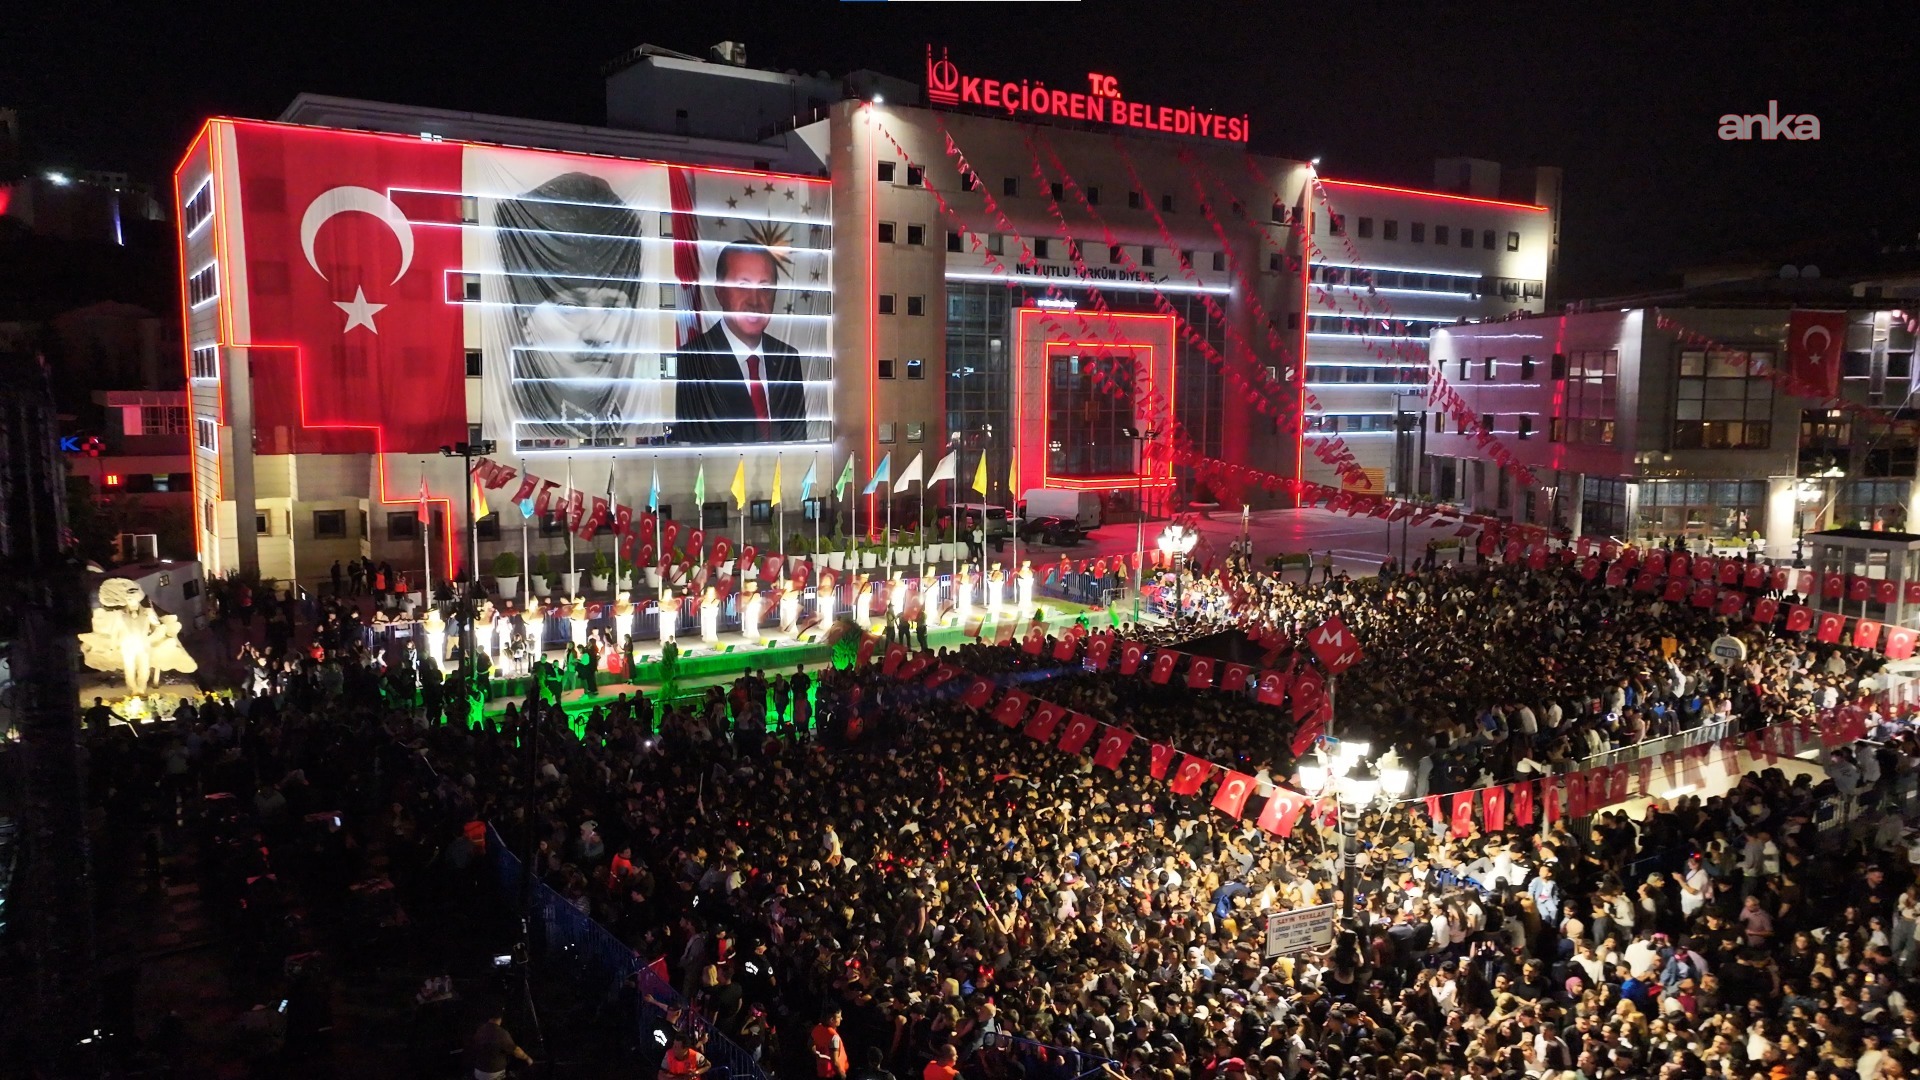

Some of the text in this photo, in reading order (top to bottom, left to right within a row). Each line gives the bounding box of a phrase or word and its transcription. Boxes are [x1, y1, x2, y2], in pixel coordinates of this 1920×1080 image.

[1088, 72, 1121, 98] T.C.
[962, 75, 1249, 143] KEÇİÖREN BELEDİYESİ
[1016, 263, 1030, 275] NE
[1317, 628, 1342, 647] M
